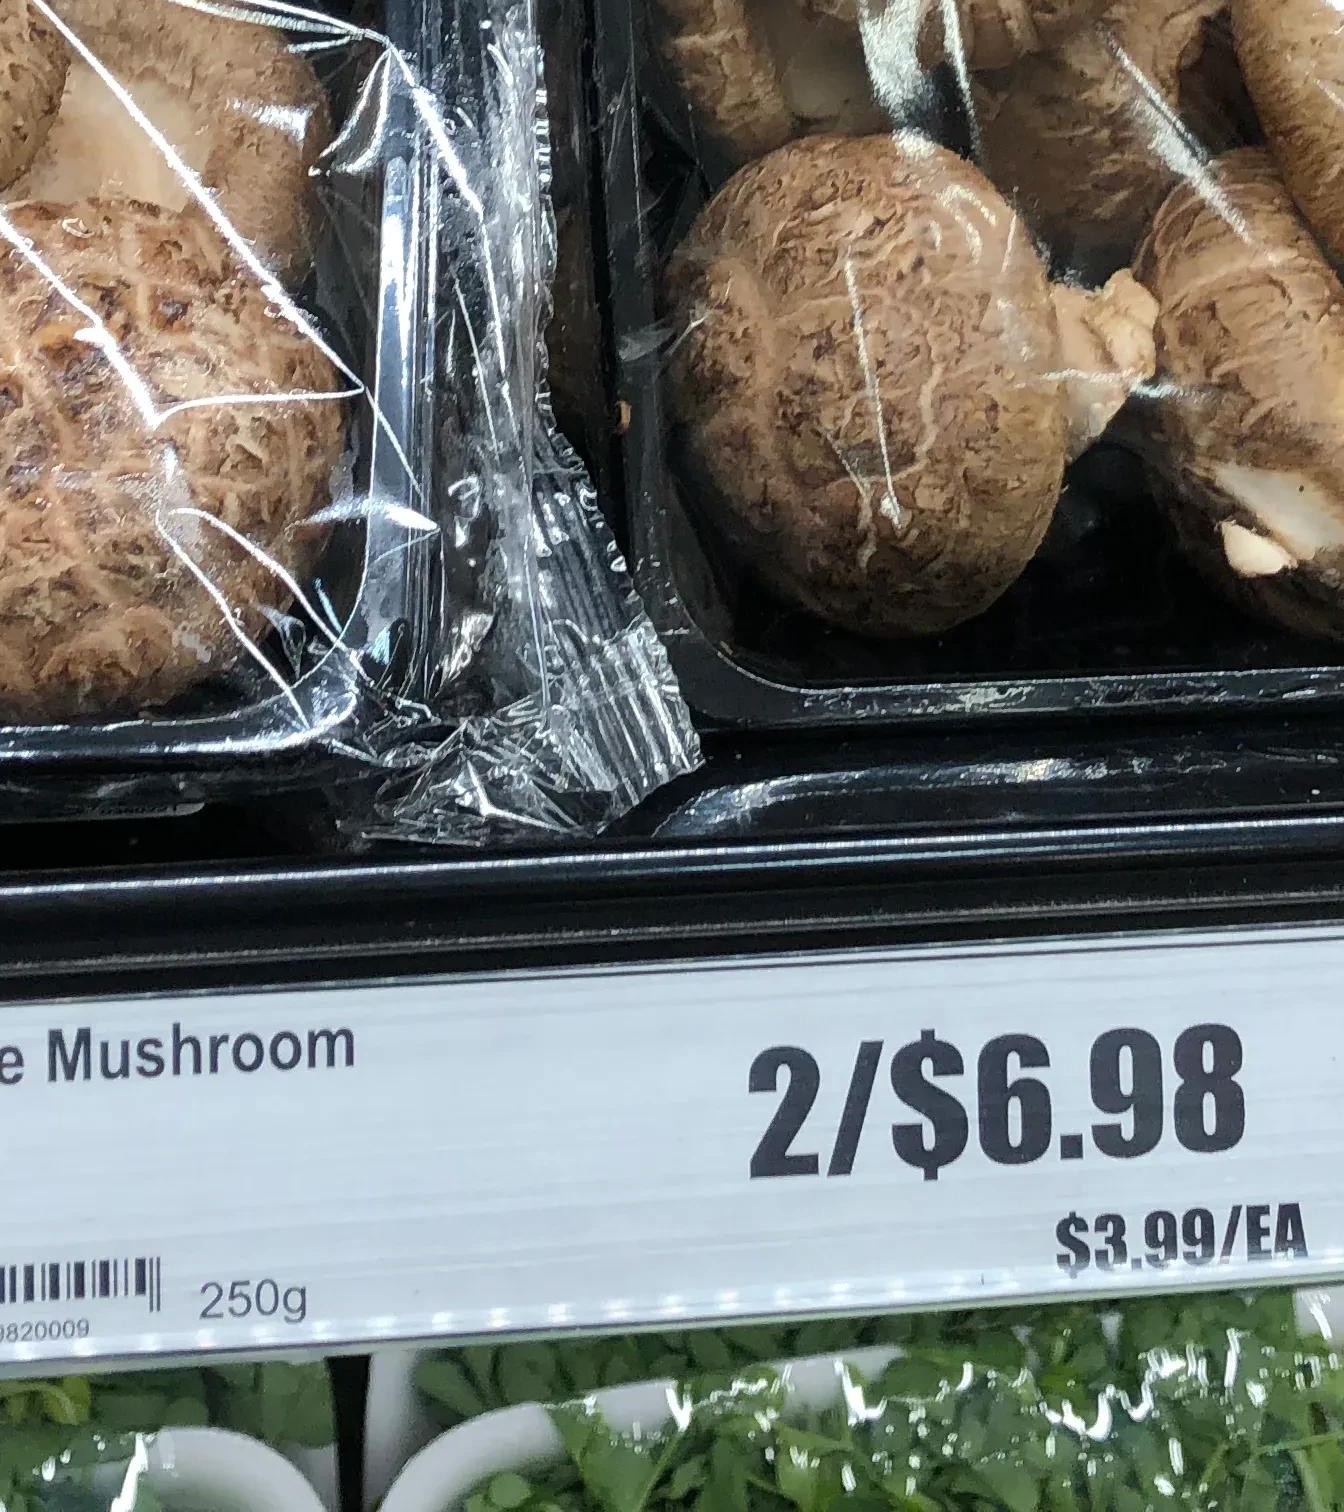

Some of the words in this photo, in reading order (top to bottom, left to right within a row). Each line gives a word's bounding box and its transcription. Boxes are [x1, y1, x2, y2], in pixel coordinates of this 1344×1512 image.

[46, 1021, 357, 1084] Mushroom
[747, 1022, 1247, 1181] 2/$6.98
[1055, 1201, 1310, 1280] $3.99/EA
[199, 1277, 309, 1323] 250g
